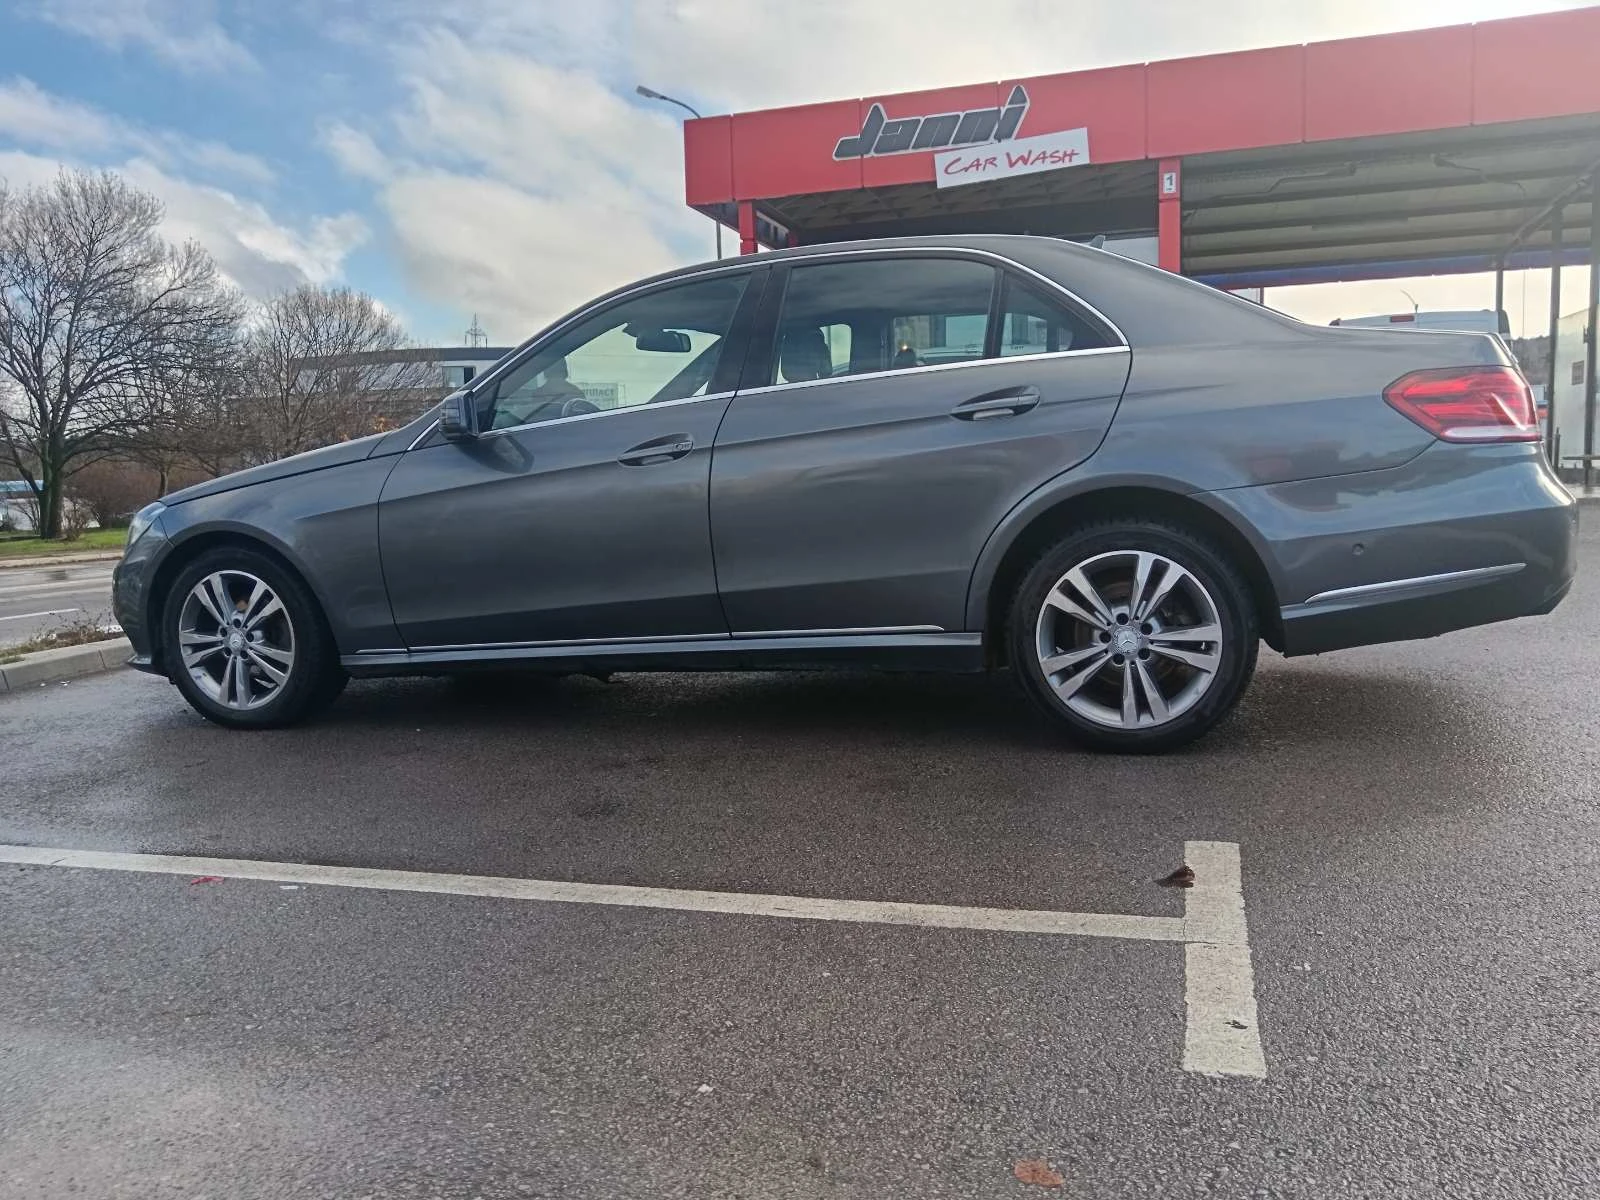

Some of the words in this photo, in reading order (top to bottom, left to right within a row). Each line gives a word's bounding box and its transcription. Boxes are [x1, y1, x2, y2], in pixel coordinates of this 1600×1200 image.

[943, 157, 997, 176] CAR
[1006, 149, 1080, 169] WASH
[1165, 175, 1174, 187] 1
